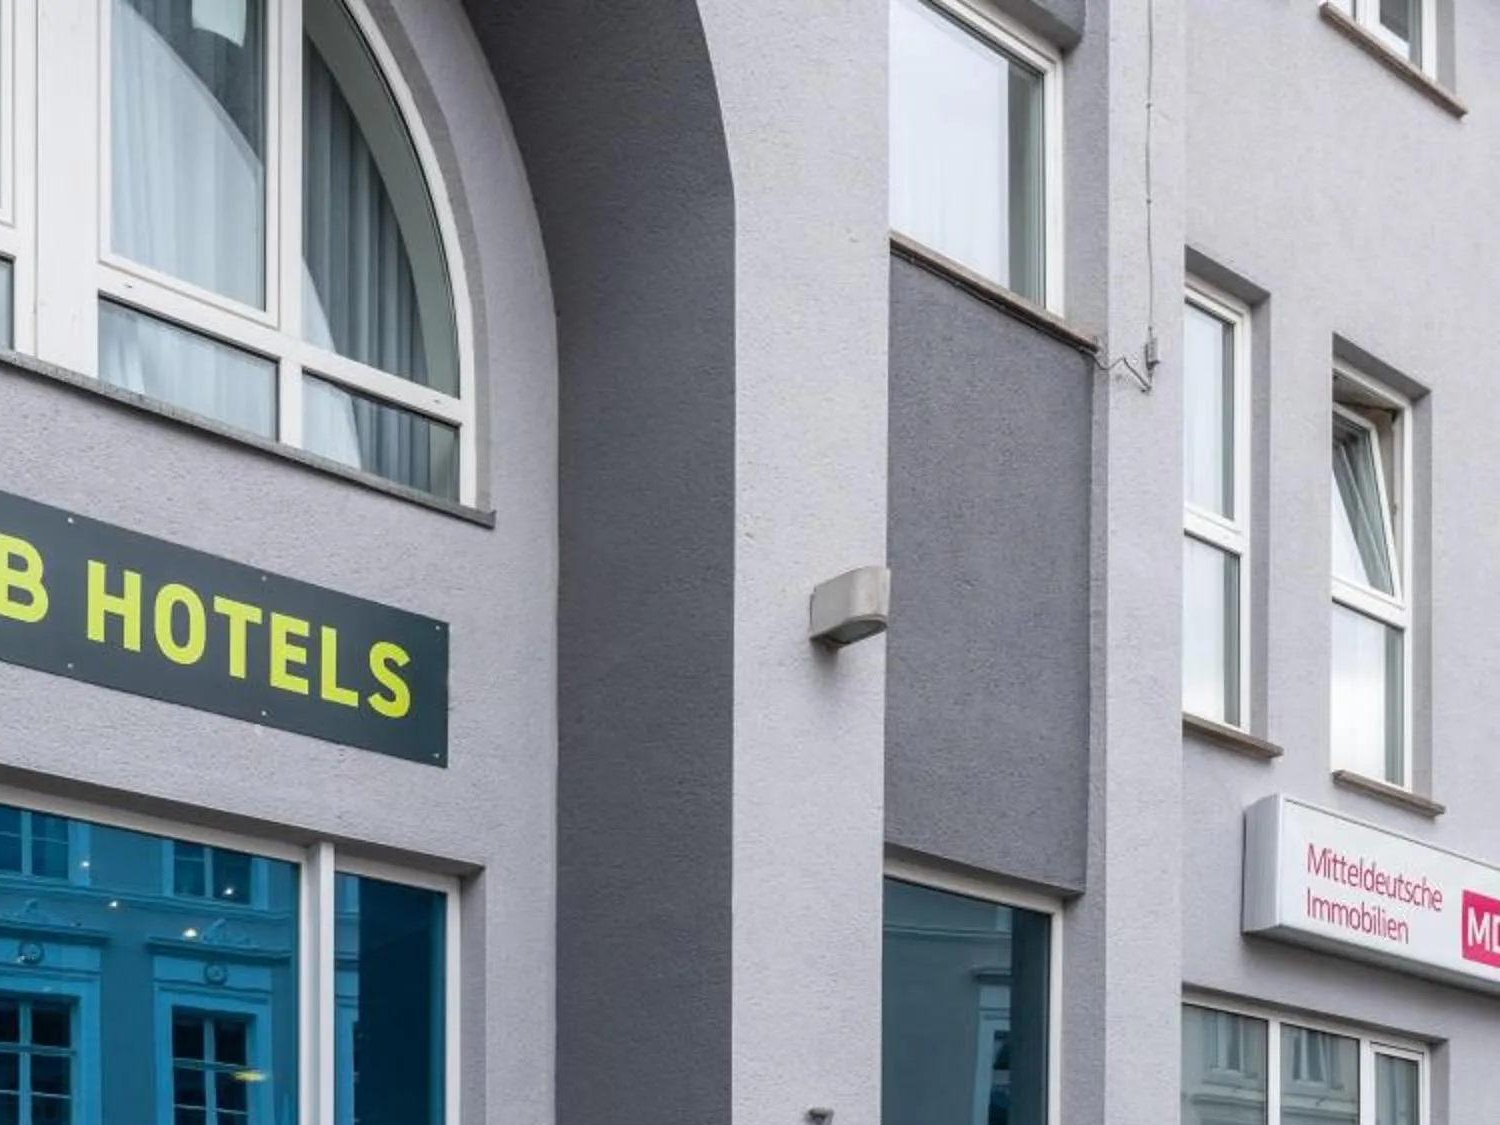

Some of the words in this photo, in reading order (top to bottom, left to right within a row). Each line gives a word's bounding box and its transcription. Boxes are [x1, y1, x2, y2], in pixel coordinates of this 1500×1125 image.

[86, 559, 412, 718] HOTELS
[1306, 843, 1443, 912] Mitteldeutsche
[1306, 888, 1409, 945] Immobilien
